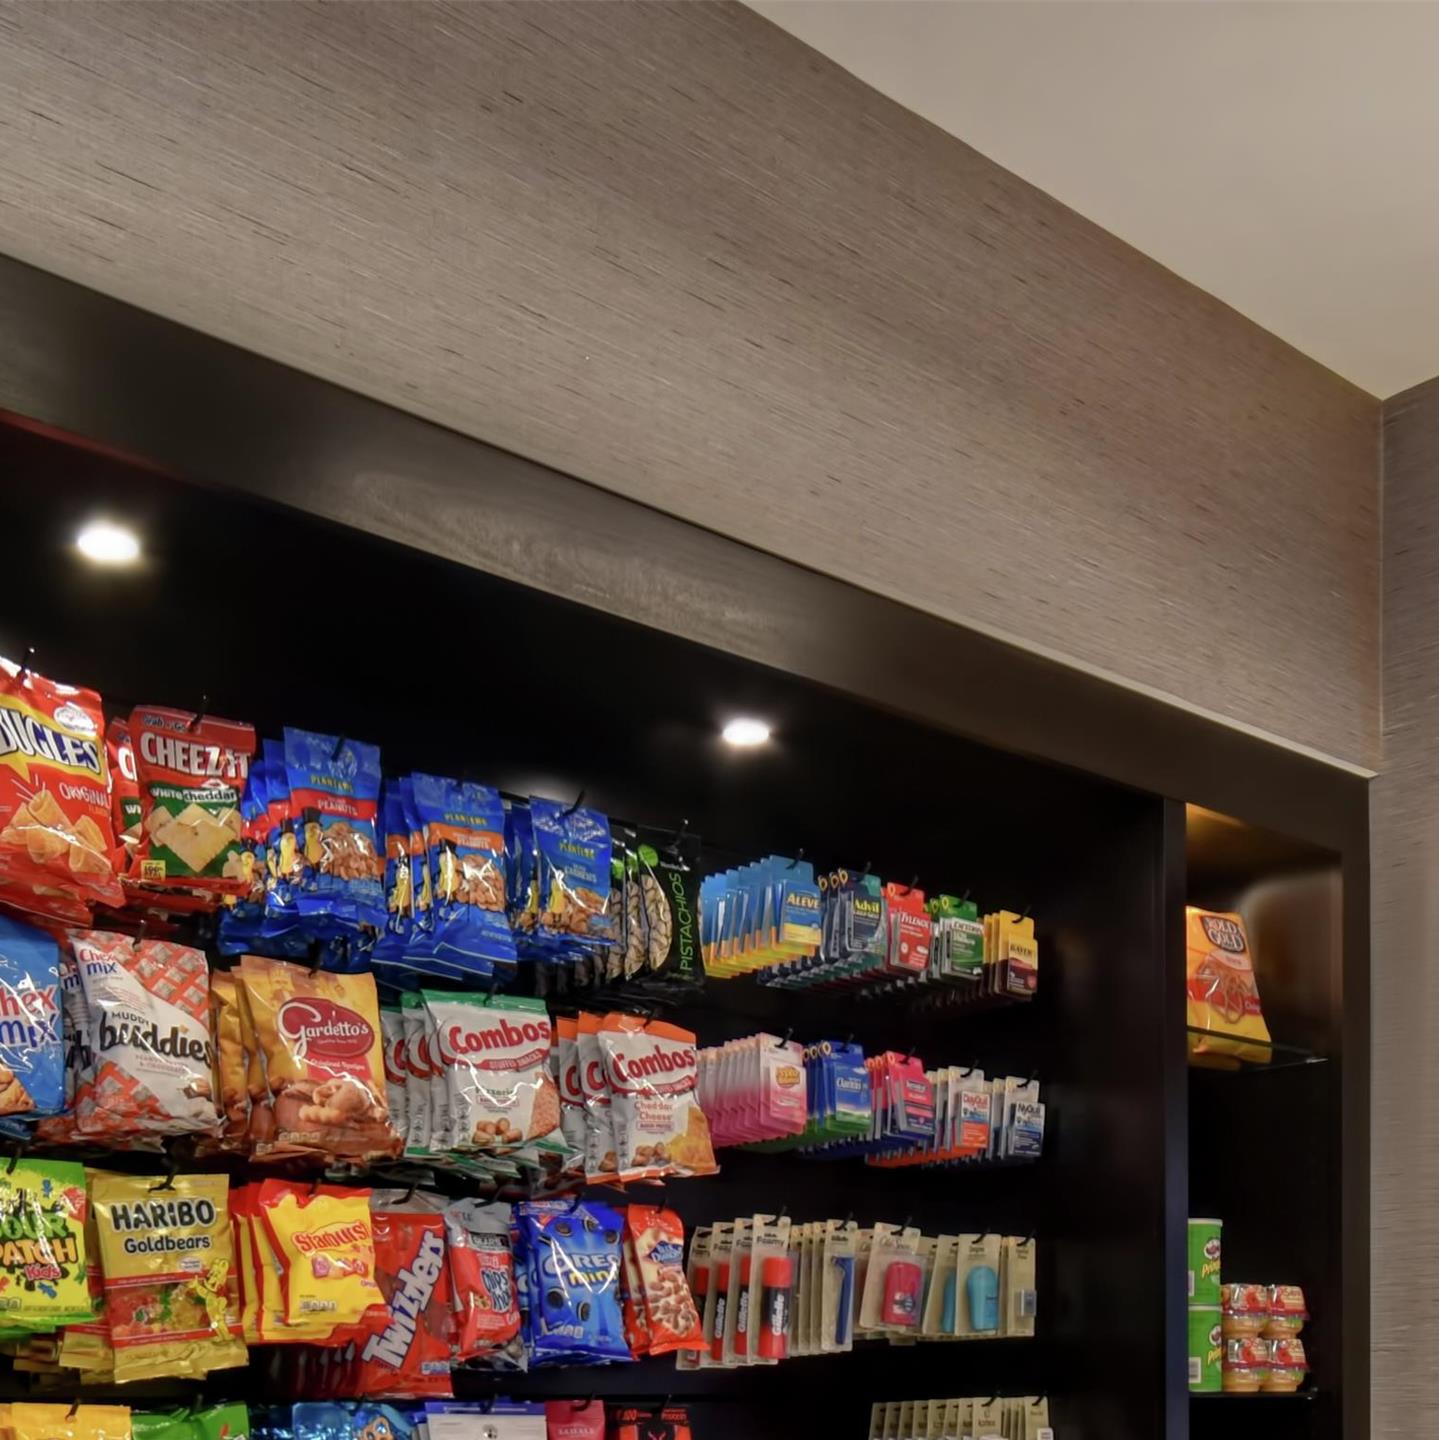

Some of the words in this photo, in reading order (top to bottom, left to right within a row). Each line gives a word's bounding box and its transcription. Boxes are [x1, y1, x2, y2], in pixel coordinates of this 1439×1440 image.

[667, 872, 694, 972] PISTACHIOS
[854, 898, 880, 914] Advil
[86, 961, 118, 975] mix
[448, 1019, 551, 1055] Combos
[612, 1046, 696, 1082] Combos
[111, 1199, 216, 1231] HARIBO
[124, 1235, 210, 1253] Goldbears
